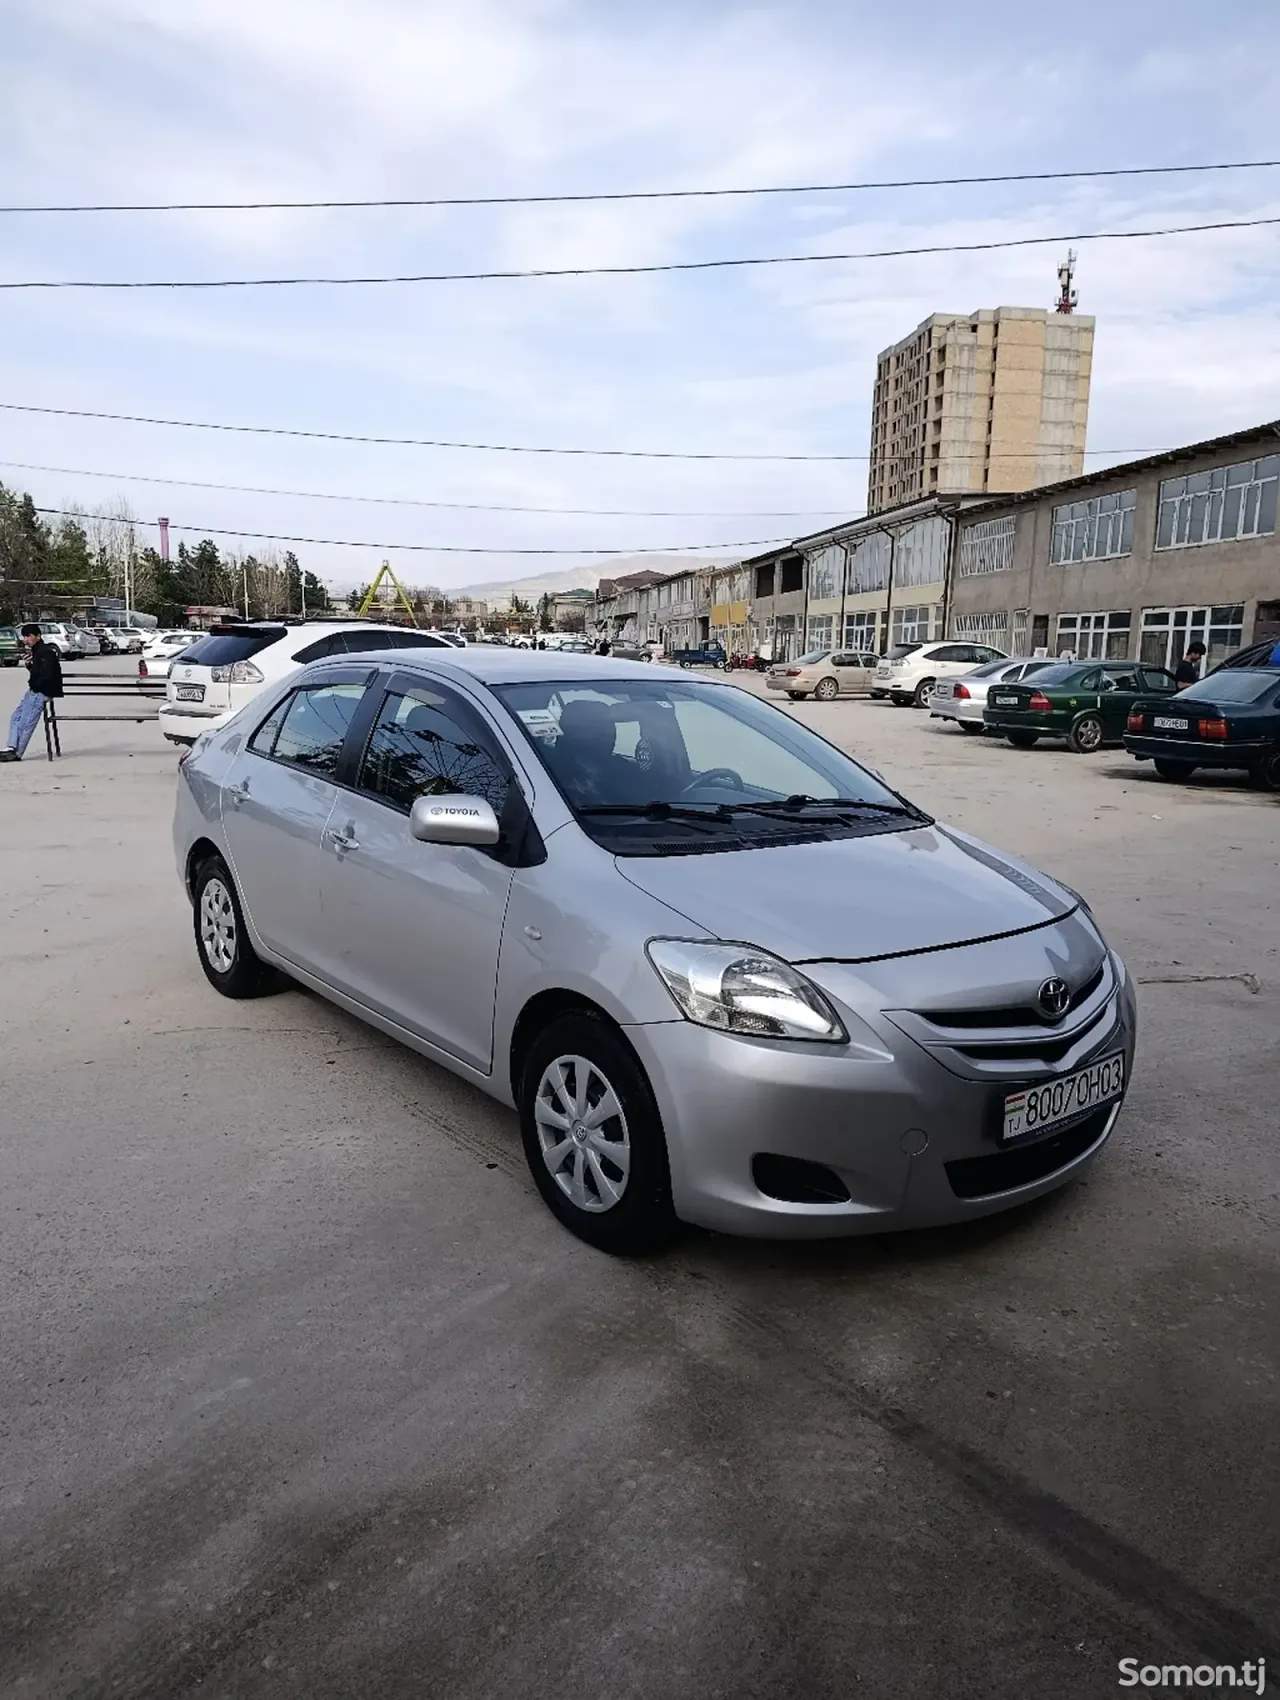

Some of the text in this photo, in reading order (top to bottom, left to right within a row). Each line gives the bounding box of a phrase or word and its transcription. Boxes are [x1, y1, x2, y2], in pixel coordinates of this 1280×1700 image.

[444, 807, 480, 816] TOYOTA
[1026, 1058, 1121, 1126] 8007OH03
[1008, 1116, 1021, 1133] TJ
